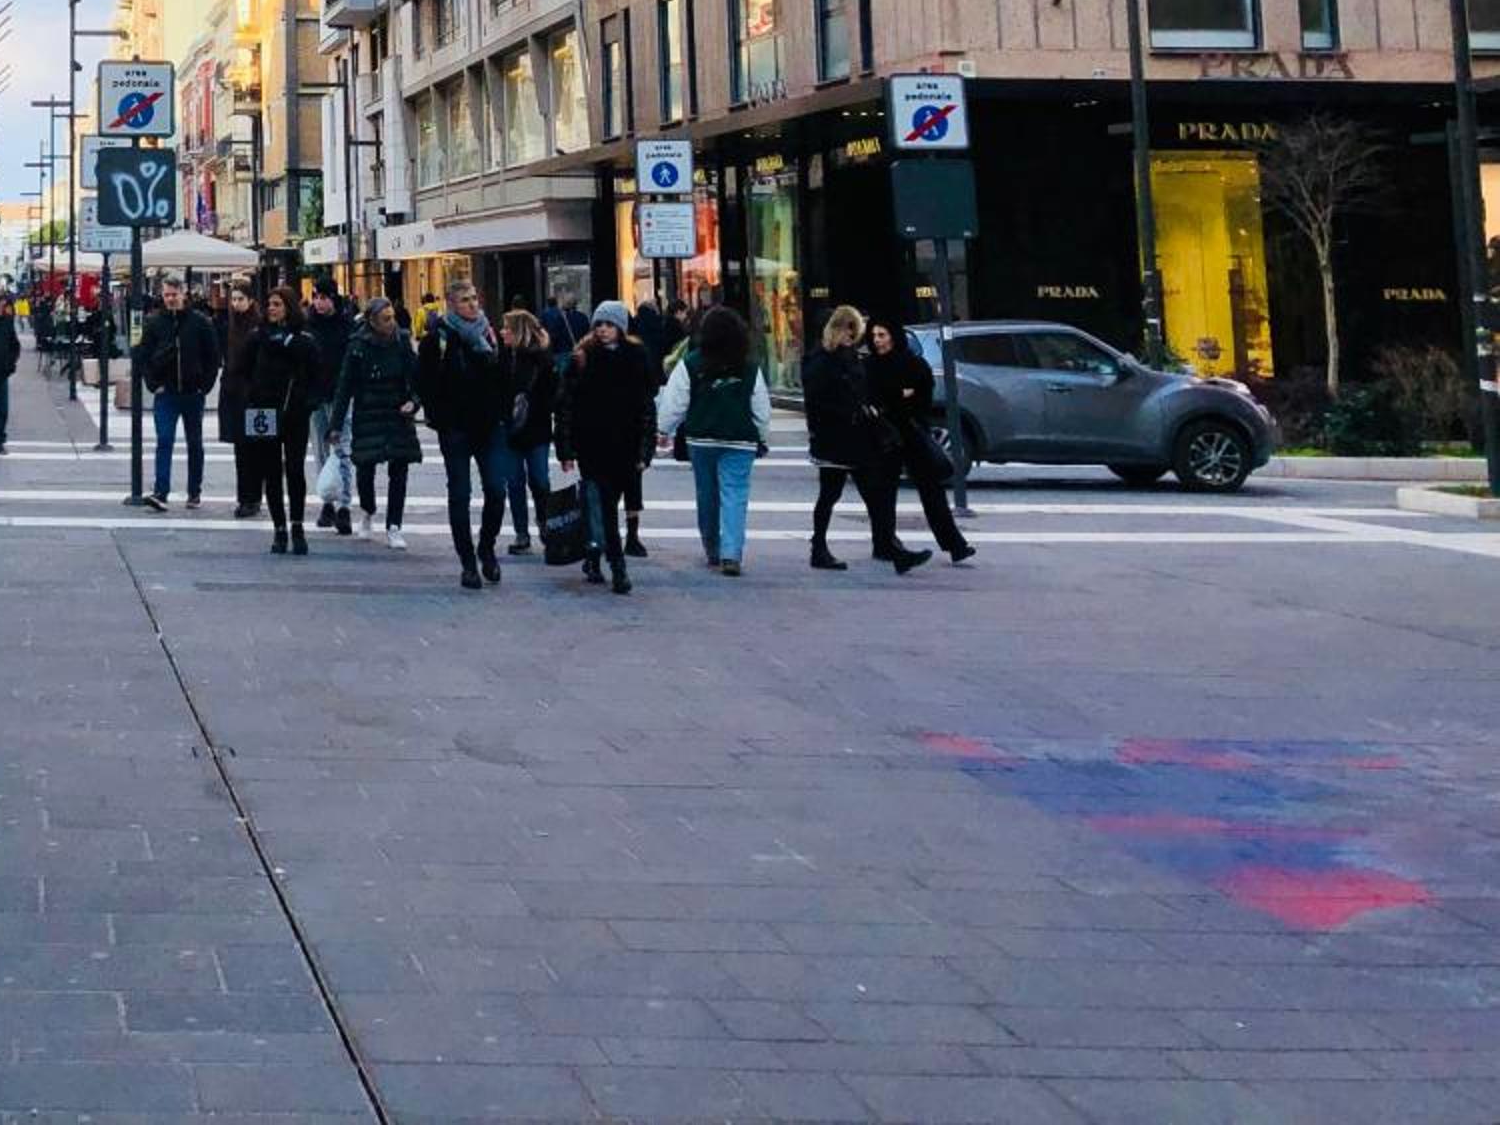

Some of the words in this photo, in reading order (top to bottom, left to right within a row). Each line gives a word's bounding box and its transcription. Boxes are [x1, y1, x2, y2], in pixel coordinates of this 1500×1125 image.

[1199, 52, 1355, 79] PRADA
[112, 78, 160, 88] pedonale
[1179, 122, 1280, 140] PRADA
[1037, 286, 1100, 298] PRADA
[1383, 287, 1446, 300] PRADA
